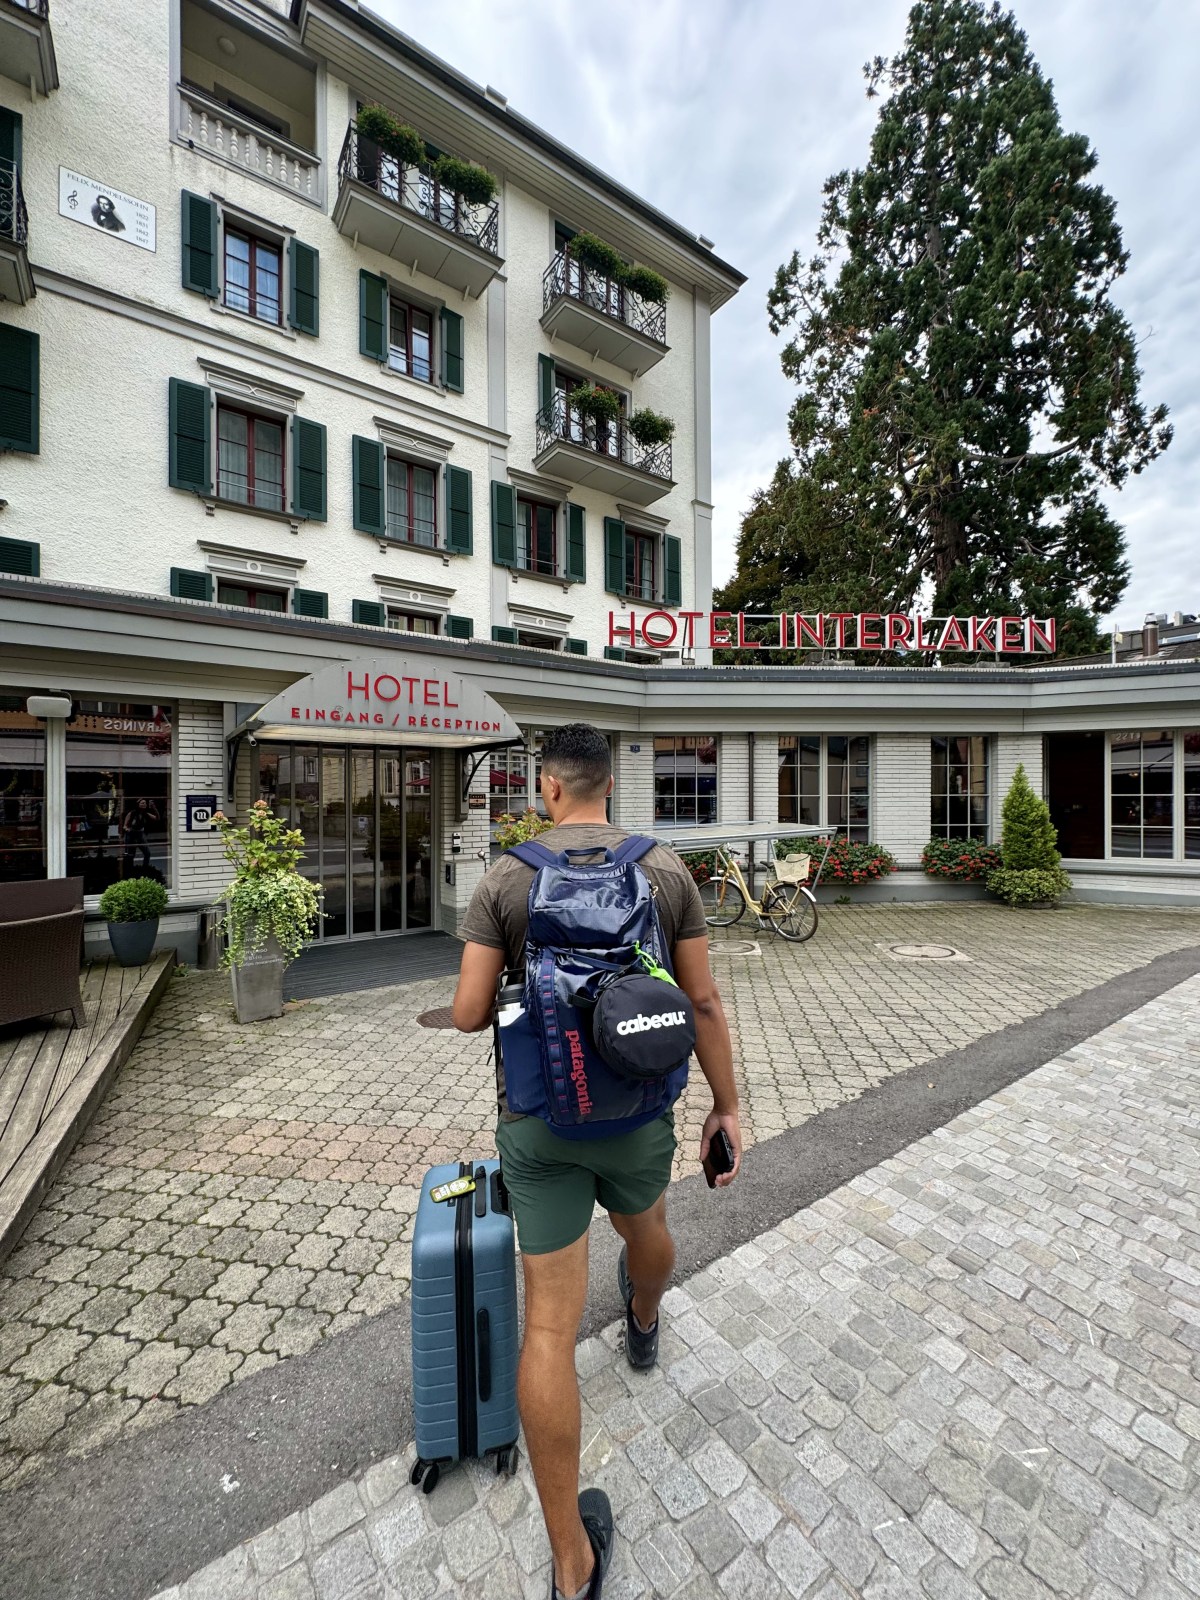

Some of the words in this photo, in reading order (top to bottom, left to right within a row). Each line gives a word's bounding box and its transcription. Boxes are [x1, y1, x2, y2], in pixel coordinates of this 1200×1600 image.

[67, 173, 89, 187] FELIX
[90, 183, 149, 211] MENDELSSOHN
[608, 610, 761, 649] HOTEL
[781, 612, 1056, 654] INTERLAKEN
[347, 671, 458, 708] HOTEL
[290, 707, 384, 724] EINGANG
[392, 714, 400, 727] /
[407, 713, 501, 732] RÉCEPTION
[616, 1010, 686, 1036] cabeau
[564, 1029, 594, 1116] patagonia
